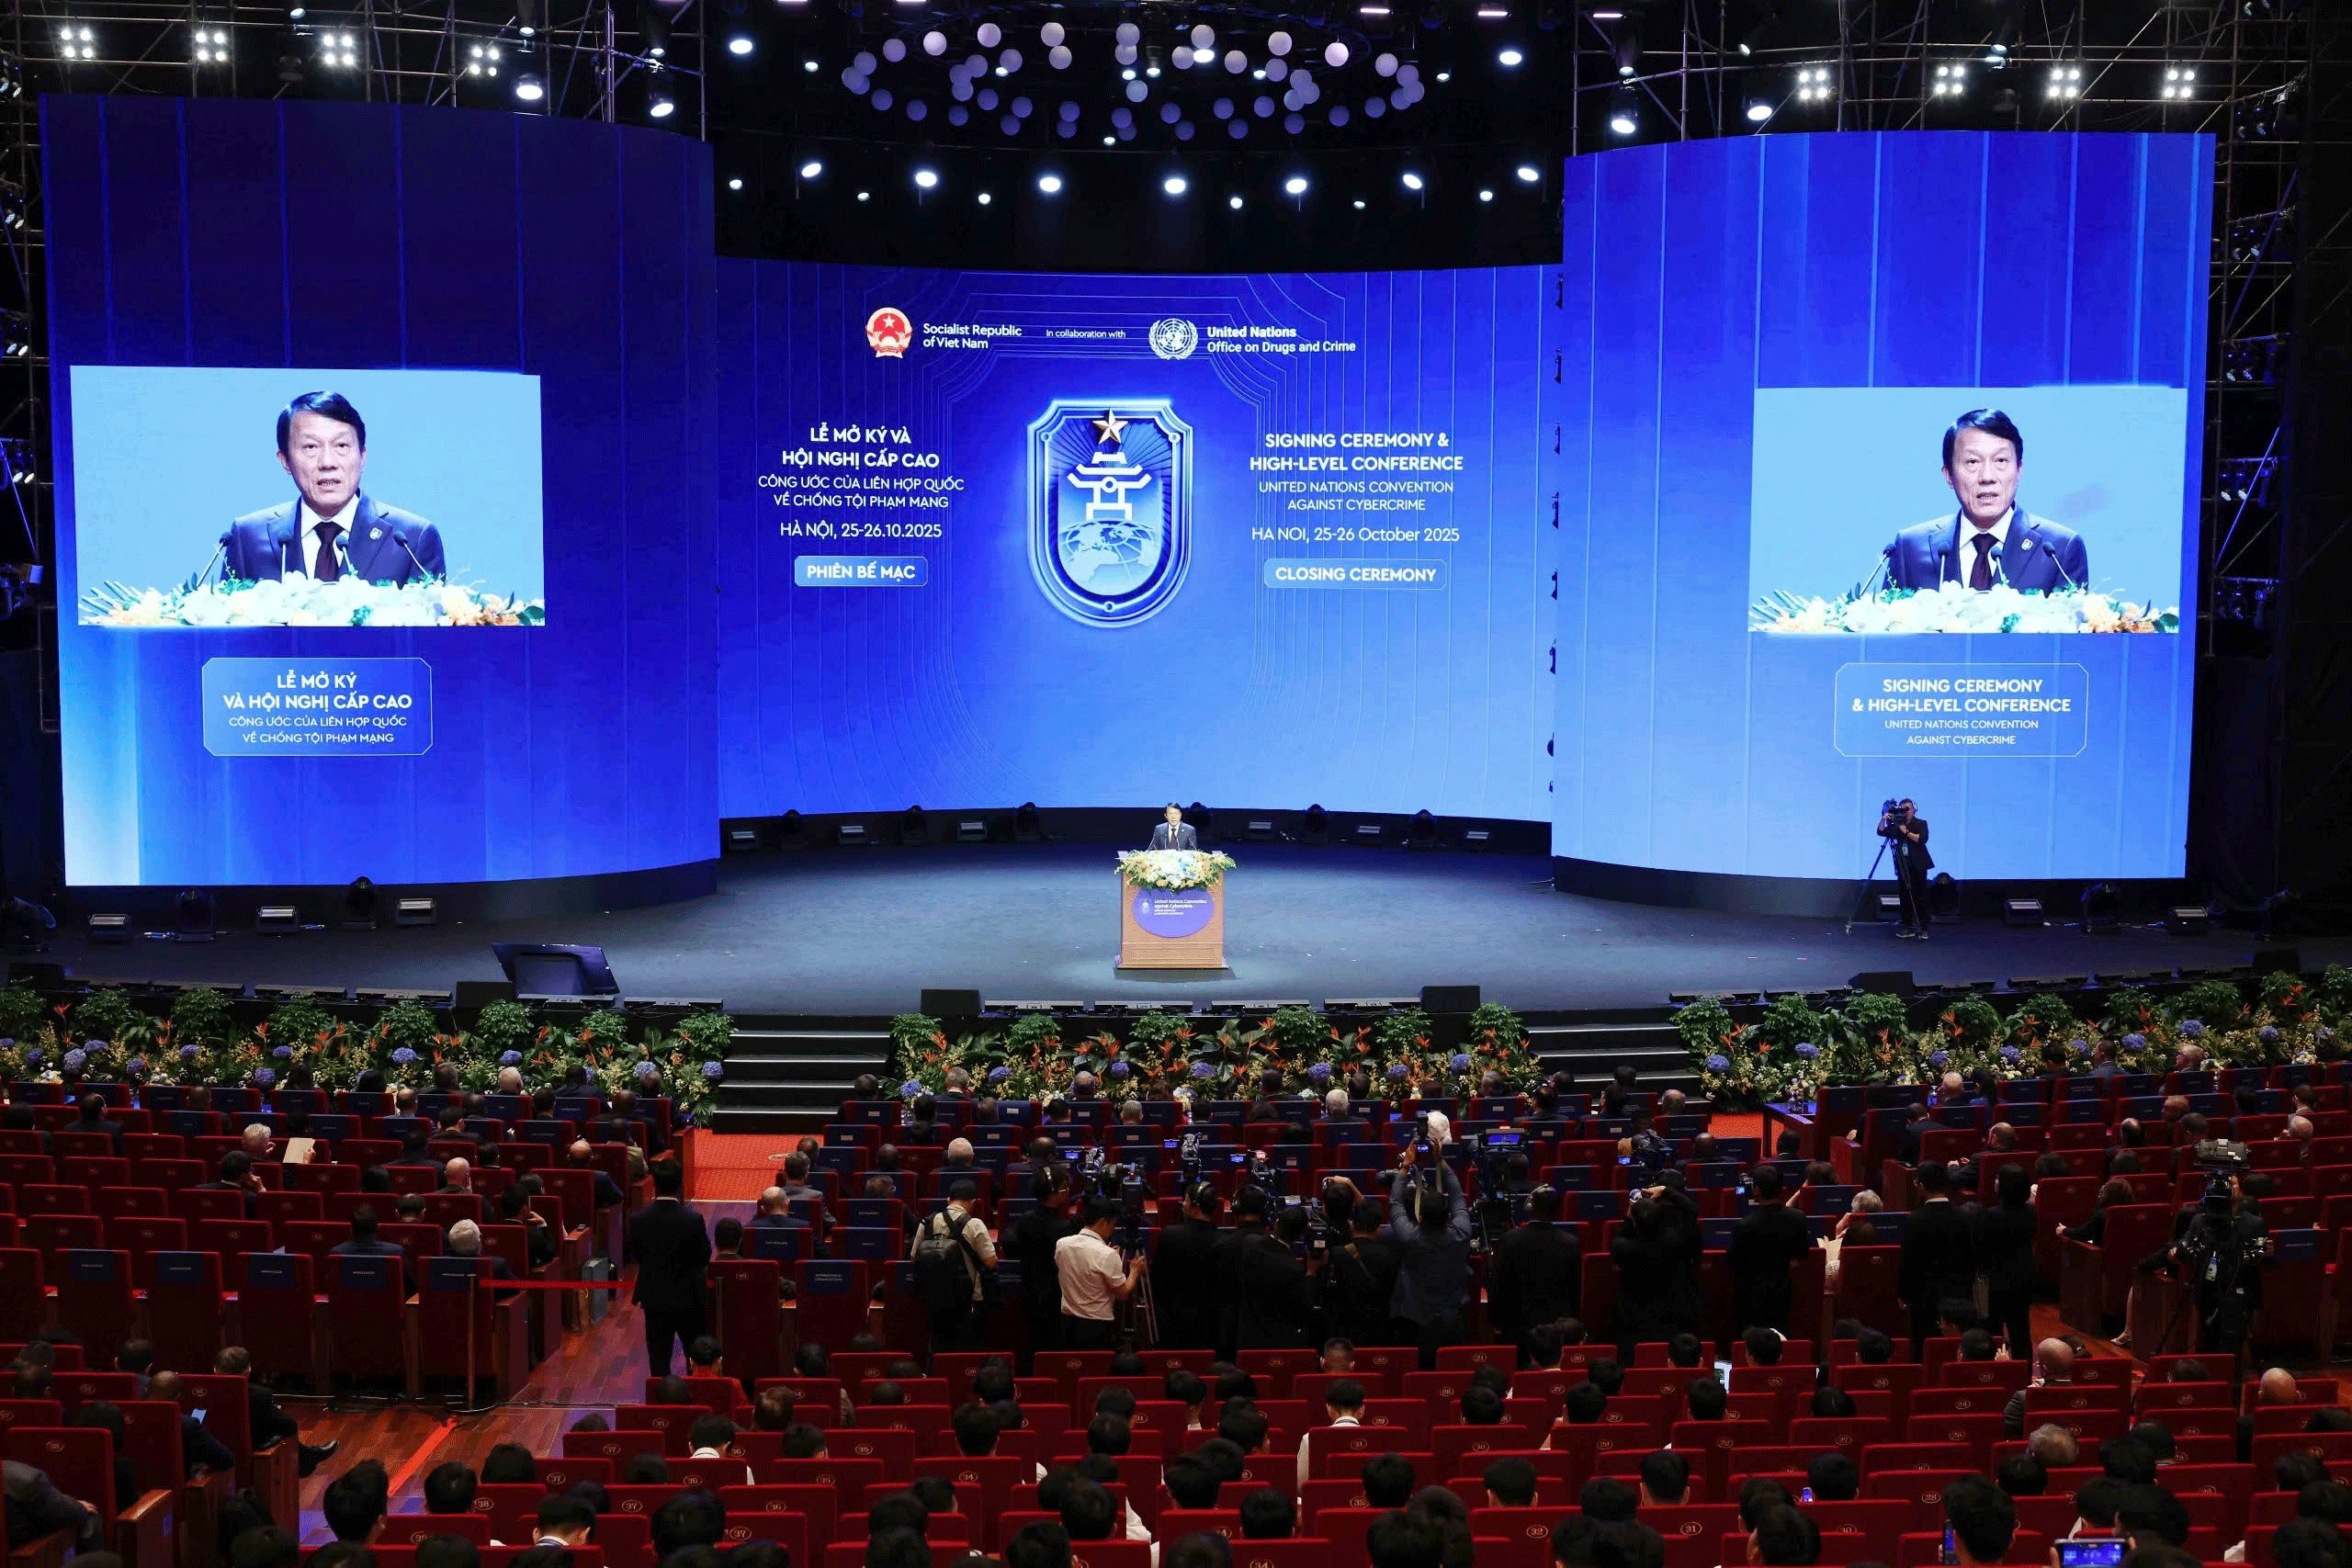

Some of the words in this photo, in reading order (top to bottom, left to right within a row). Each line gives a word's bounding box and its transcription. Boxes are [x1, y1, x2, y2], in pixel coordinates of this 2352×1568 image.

[923, 323, 969, 336] Socialist
[973, 324, 1022, 337] Republic
[1056, 329, 1106, 338] collaboration
[1108, 330, 1125, 339] with
[1207, 326, 1247, 337] United
[1250, 326, 1296, 337] Nations
[923, 336, 935, 347] of
[936, 337, 959, 347] Viet
[963, 338, 988, 348] Nam
[1207, 341, 1240, 352] Office
[1245, 344, 1259, 352] on
[1262, 342, 1295, 355] Drugs
[1299, 341, 1319, 352] and
[1323, 341, 1355, 352] Crime
[811, 423, 829, 442] LỄ
[834, 424, 861, 443] MỞ
[865, 426, 888, 443] KÝ
[890, 426, 911, 444] VÀ
[1265, 434, 1336, 447] SIGNING
[1340, 434, 1434, 447] CEREMONY
[1438, 433, 1449, 446] &
[783, 447, 812, 468] HỘI
[818, 452, 859, 469] NGHỊ
[865, 448, 898, 467] CẤP
[902, 454, 939, 468] CAO
[1250, 457, 1348, 470] HIGH-LEVEL
[1351, 457, 1463, 470] CONFERENCE
[759, 474, 797, 488] CÔNG
[833, 475, 860, 489] CỦA
[864, 476, 889, 489] LIÊN
[894, 478, 922, 491] HỢP
[924, 476, 964, 492] QUỐC
[1260, 481, 1306, 492] UNITED
[1310, 481, 1365, 492] NATIONS
[1369, 481, 1453, 492] CONVENTION
[794, 491, 842, 506] CHỐNG
[844, 493, 865, 509] TỘI
[870, 496, 905, 509] PHẠM
[910, 497, 948, 510] MẠNG
[1288, 499, 1343, 510] AGAINST
[1346, 499, 1426, 510] CYBERCRIME
[781, 520, 802, 536] HÀ
[807, 520, 836, 539] NỘI,
[842, 524, 942, 537] 25-26.10.2025
[1315, 527, 1354, 541] 25-26
[1359, 526, 1420, 541] October
[1424, 528, 1459, 541] 2025
[808, 562, 853, 578] PHIÊN
[857, 561, 876, 578] BẾ
[881, 566, 915, 581] MẠC
[1275, 567, 1345, 581] CLOSING
[1350, 568, 1436, 581] CEREMONY
[277, 670, 296, 688] LỄ
[301, 671, 329, 688] MỞ
[334, 672, 356, 688] KÝ
[1883, 679, 1950, 693] SIGNING
[1954, 679, 2042, 693] CEREMONY
[223, 693, 245, 708] VÀ
[249, 693, 279, 712] HỘI
[286, 695, 328, 712] NGHỊ
[334, 691, 368, 708] CẤP
[373, 694, 412, 708] CAO
[1852, 698, 1863, 711] &
[1869, 698, 1962, 712] HIGH-LEVEL
[1964, 699, 2071, 712] CONFERENCE
[229, 716, 264, 727] CÔNG
[294, 715, 318, 727] CỦA
[321, 716, 343, 727] LIÊN
[346, 717, 369, 728] HỢP
[373, 715, 406, 728] QUỐC
[1885, 720, 1922, 728] UNITED
[1925, 720, 1968, 728] NATIONS
[1971, 720, 2038, 728] CONVENTION
[260, 731, 302, 742] CHỐNG
[304, 732, 322, 744] TỘI
[326, 734, 356, 744] PHẠM
[360, 733, 394, 744] MẠNG
[1907, 736, 1951, 744] AGAINST
[1953, 736, 2016, 744] CYBERCRIME
[626, 1502, 638, 1510] 37
[734, 1529, 746, 1538] 37
[1531, 1528, 1544, 1536] 32
[1685, 1525, 1696, 1533] 31
